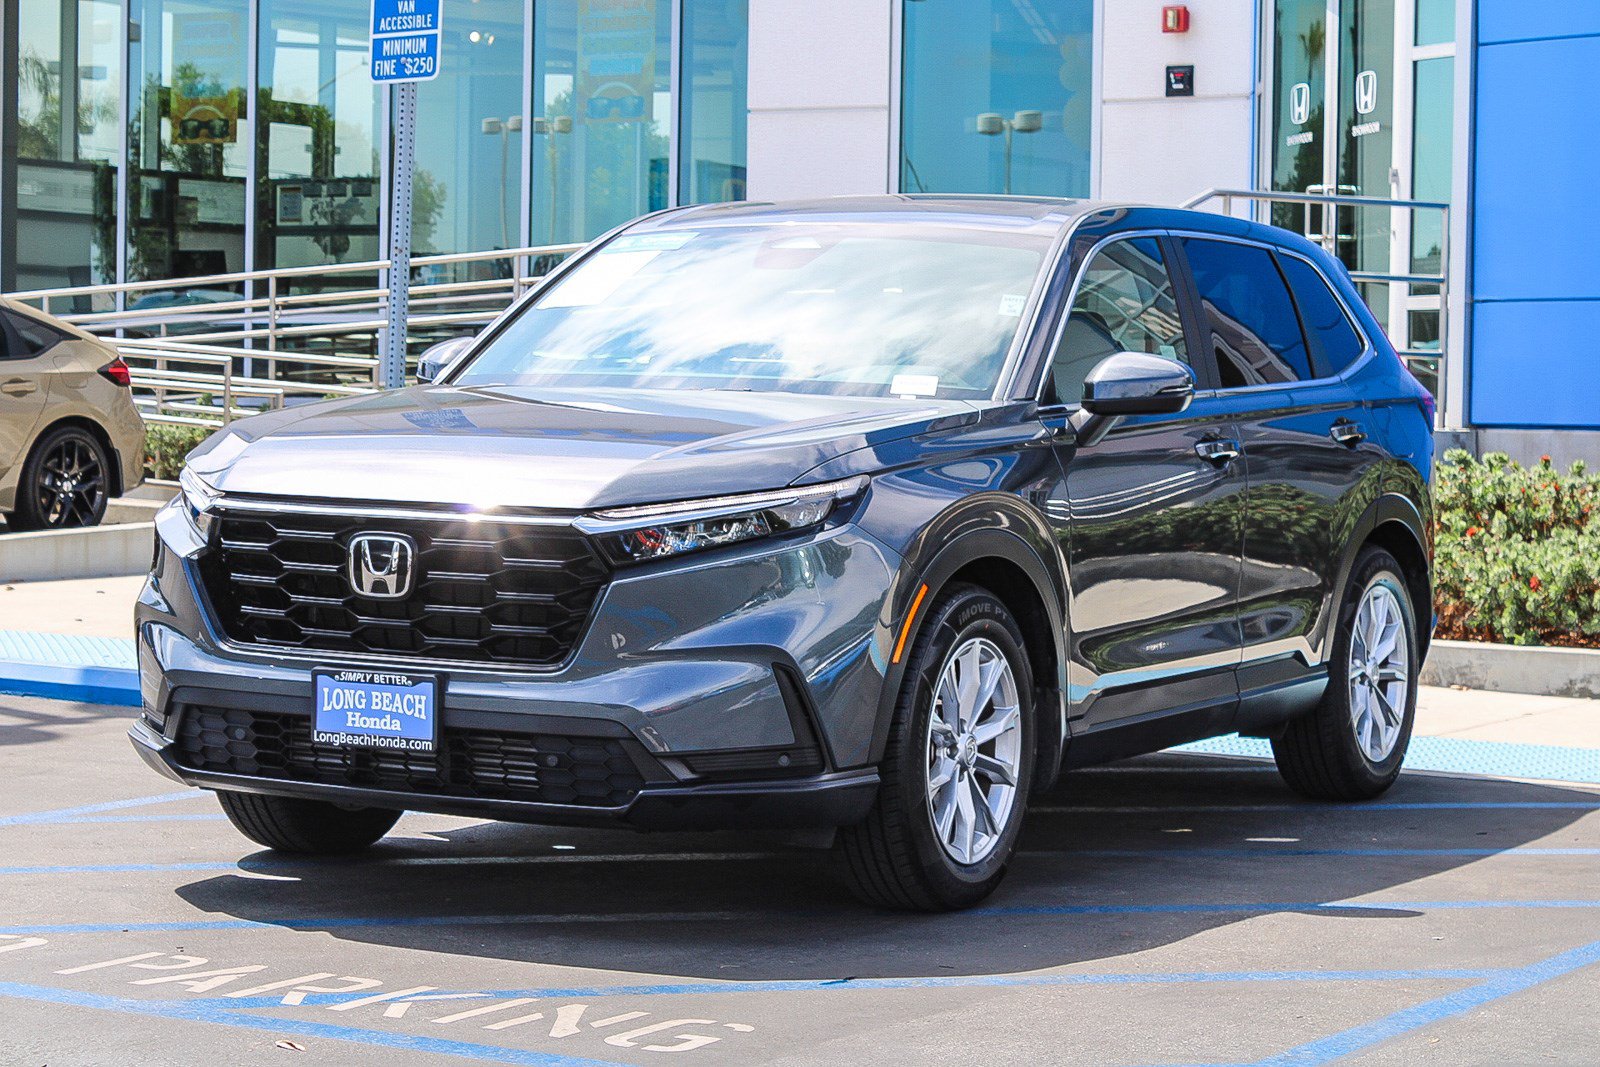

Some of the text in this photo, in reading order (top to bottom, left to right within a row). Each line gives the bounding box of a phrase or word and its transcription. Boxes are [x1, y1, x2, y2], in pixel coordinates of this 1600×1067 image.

[397, 0, 415, 14] VAN
[379, 14, 432, 31] ACCESSIBLE
[382, 37, 427, 56] MINIMUM
[374, 56, 434, 76] FINE $250
[340, 671, 408, 685] SIMPLY BETTER
[322, 687, 427, 720] LONG BEACH
[346, 711, 402, 731] Honda
[313, 730, 433, 751] LongBeachHonda.com
[52, 952, 756, 1052] PARKING
